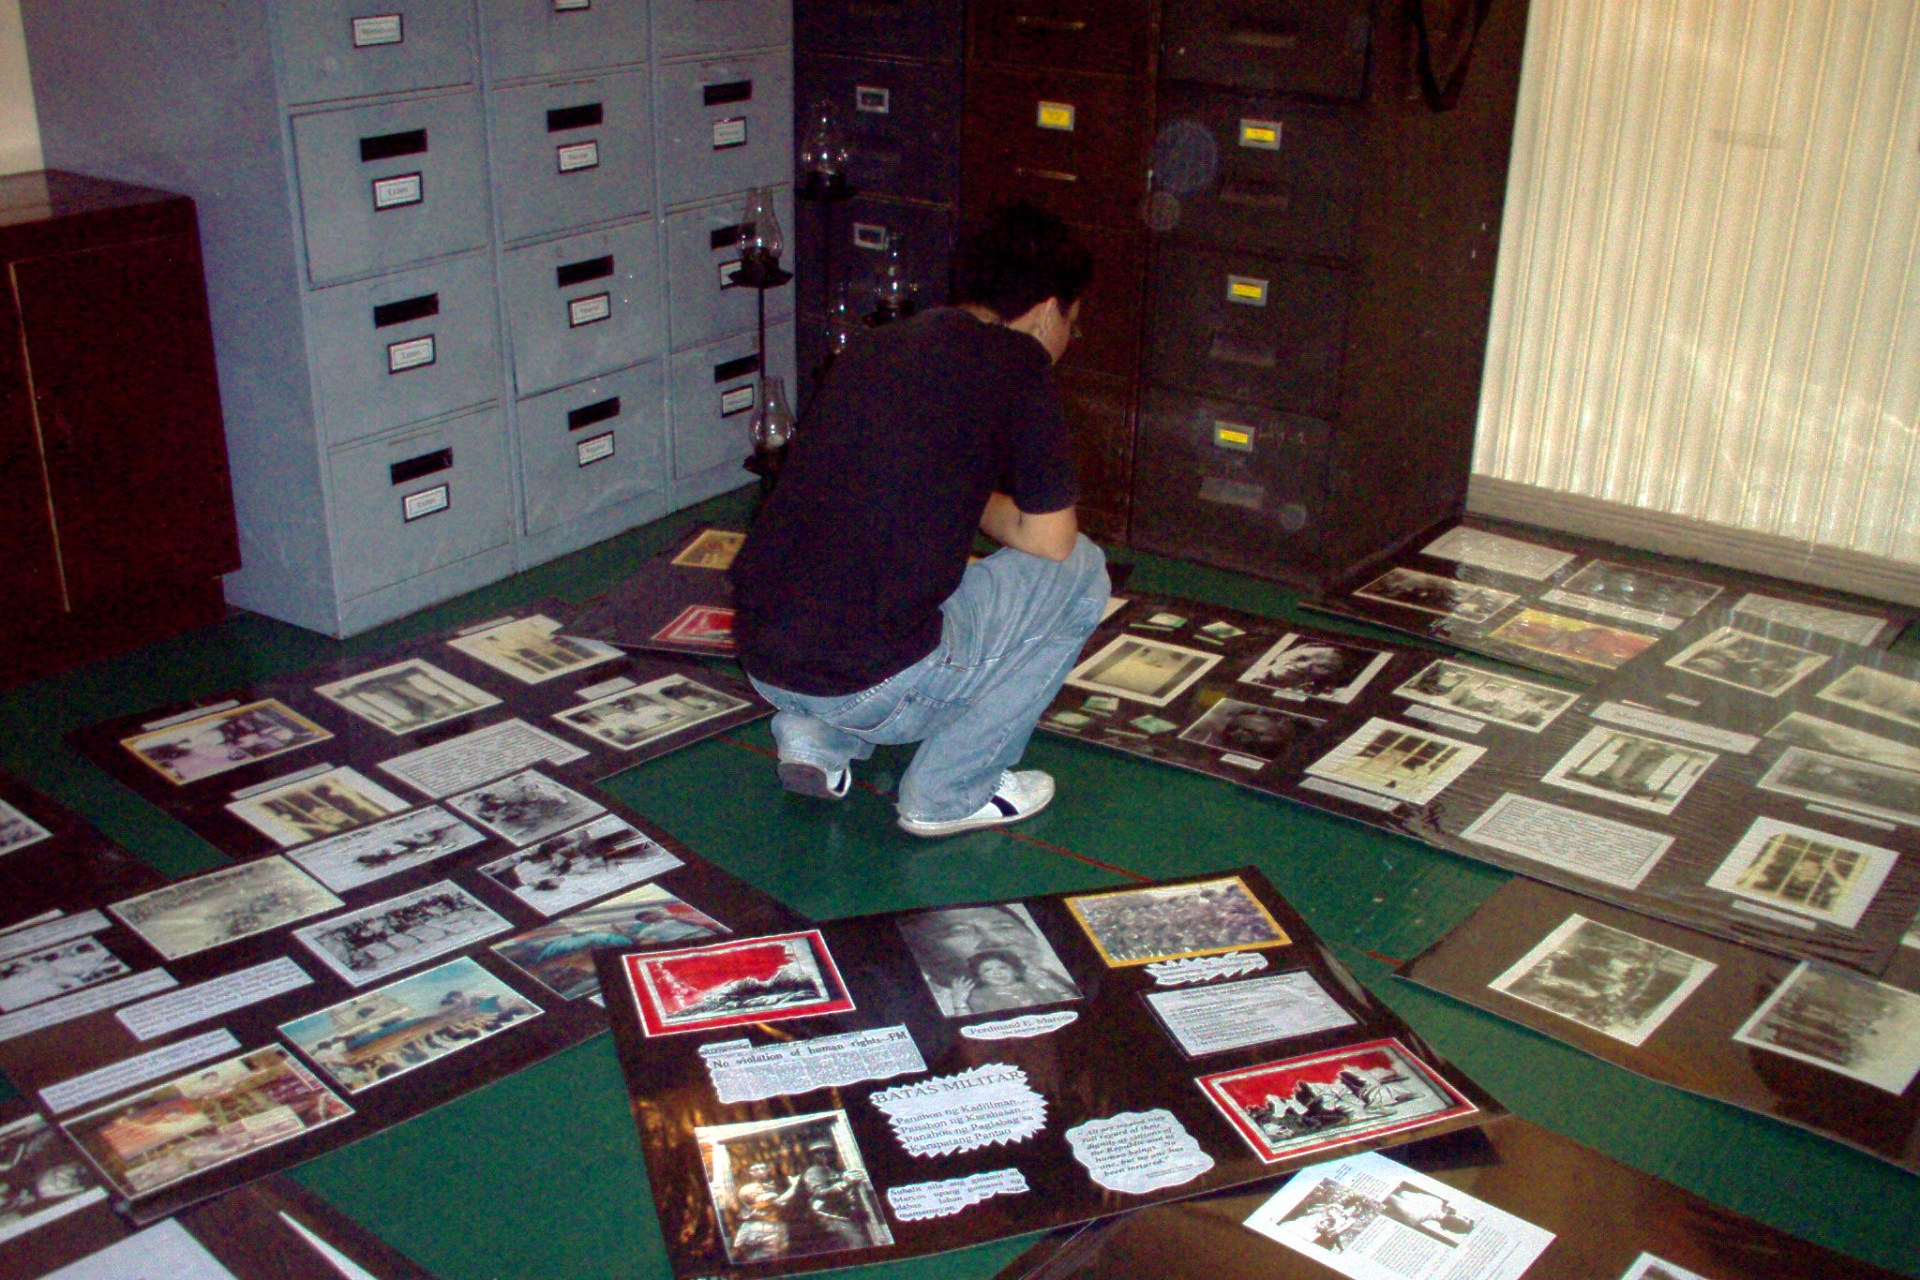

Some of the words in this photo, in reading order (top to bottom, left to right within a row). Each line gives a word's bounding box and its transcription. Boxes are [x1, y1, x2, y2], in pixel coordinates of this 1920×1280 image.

[970, 1021, 1020, 1035] Ferdinand
[1036, 1014, 1074, 1025] Marcos
[713, 1058, 729, 1070] No
[736, 1052, 783, 1065] violation
[790, 1047, 802, 1058] of
[807, 1042, 845, 1056] human
[873, 1083, 939, 1104] BATAS
[943, 1070, 1024, 1091] MILITAR
[896, 1110, 943, 1126] Panahon
[945, 1107, 959, 1118] ng
[901, 1119, 948, 1135] Panahon
[950, 1116, 963, 1126] ng
[904, 1128, 951, 1144] Panahon
[954, 1126, 968, 1136] ng
[971, 1117, 1020, 1133] Paglabag
[1022, 1114, 1034, 1122] sa
[909, 1135, 972, 1153] Karapatang
[975, 1127, 1012, 1141] Pantao
